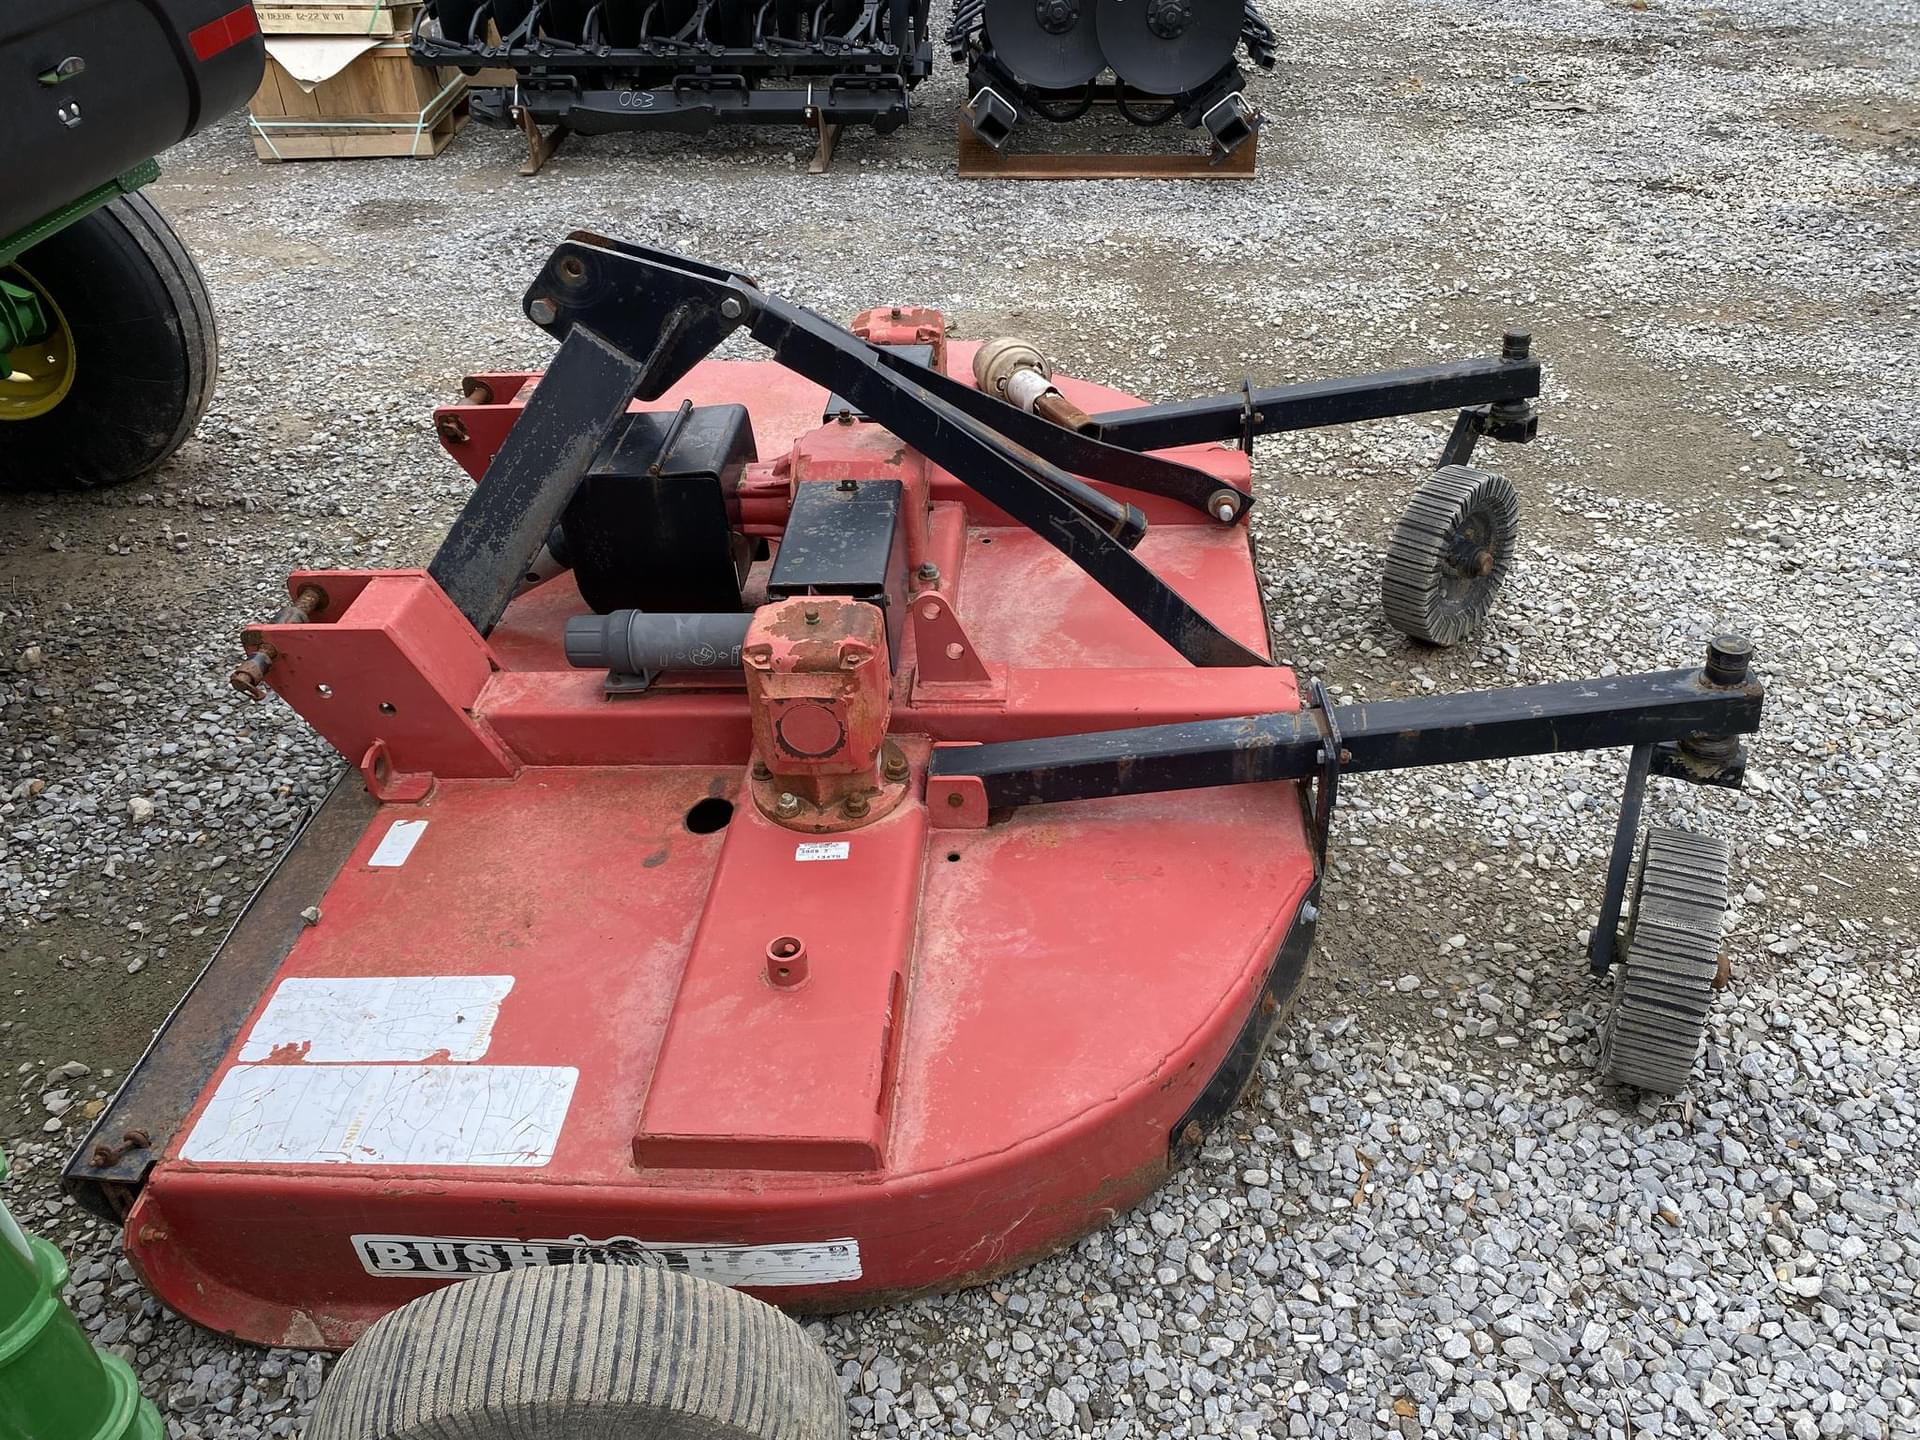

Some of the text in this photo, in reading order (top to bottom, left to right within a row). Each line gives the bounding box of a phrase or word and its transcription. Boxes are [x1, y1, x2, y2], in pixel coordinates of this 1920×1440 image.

[267, 12, 291, 20] DEERE
[619, 91, 655, 108] 063
[366, 1241, 550, 1274] BUSH
